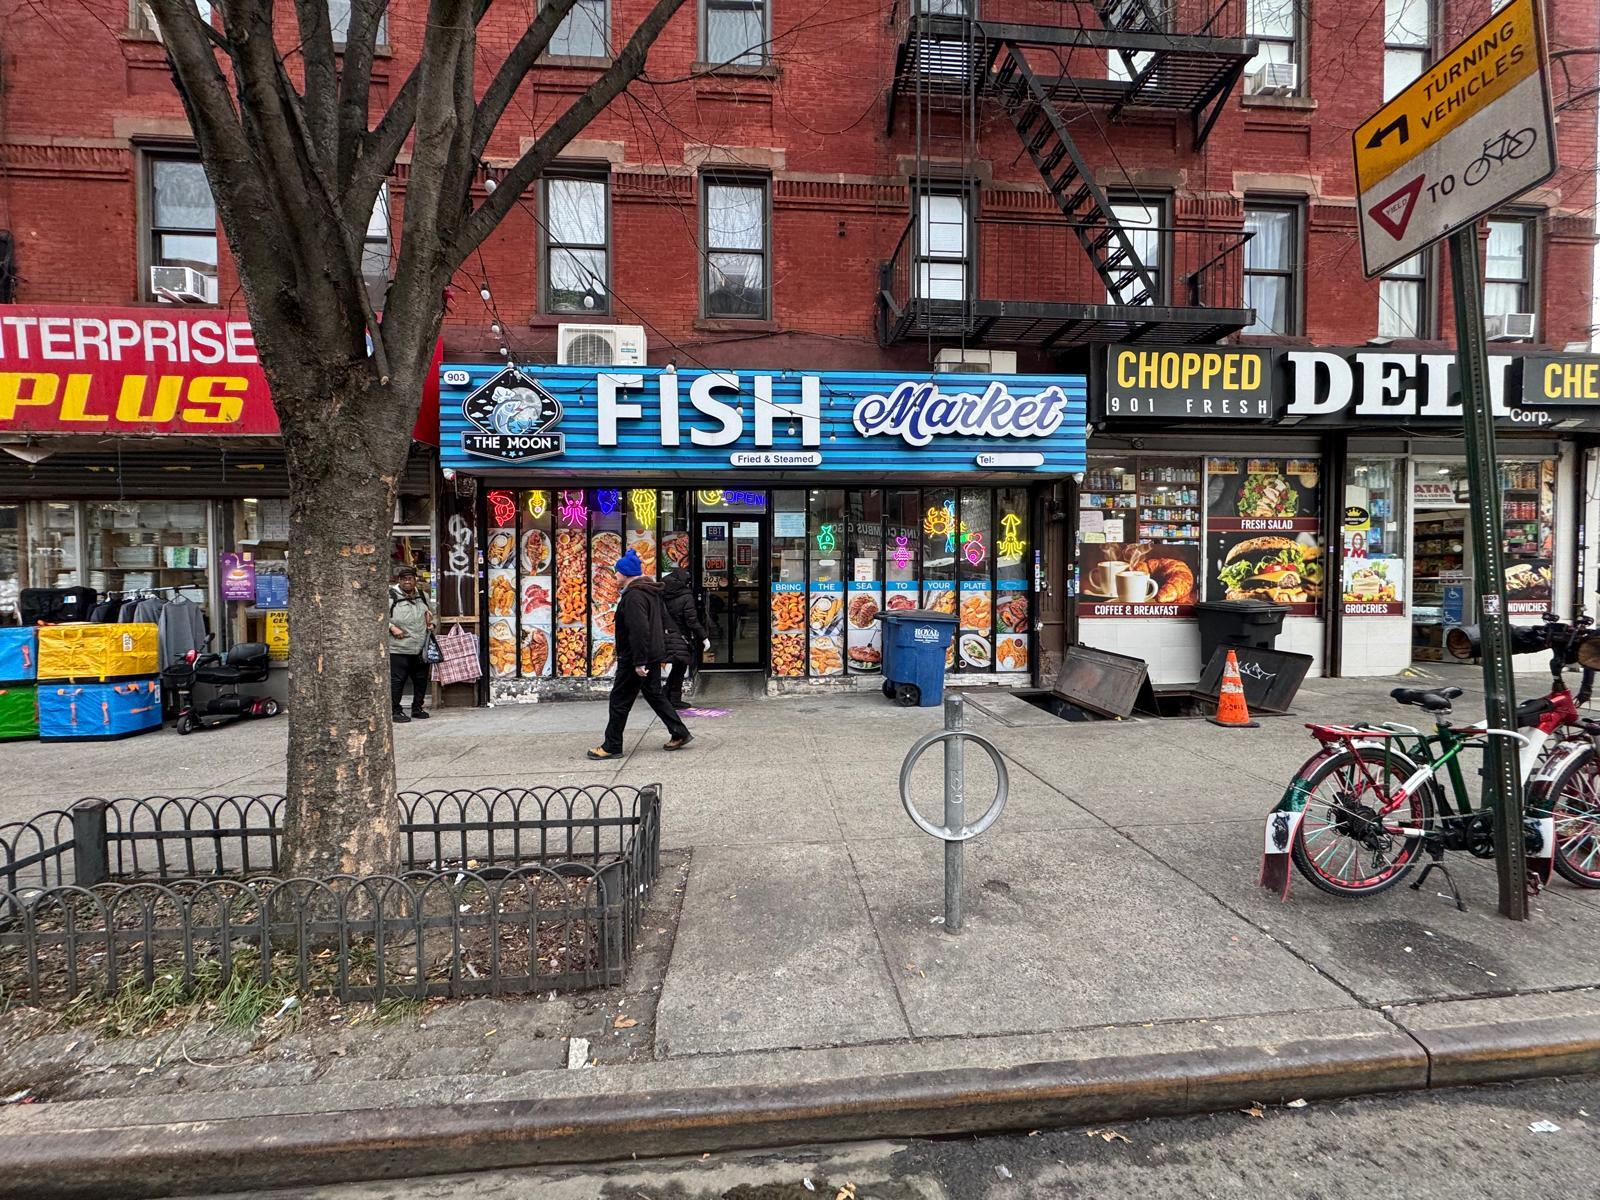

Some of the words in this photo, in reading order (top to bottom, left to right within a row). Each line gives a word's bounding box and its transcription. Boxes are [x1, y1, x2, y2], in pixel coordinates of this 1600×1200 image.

[1423, 21, 1514, 101] TURNING
[1421, 44, 1524, 129] VEHICLES
[1427, 174, 1455, 203] TO
[1385, 198, 1408, 215] YIELD
[1117, 350, 1262, 391] CHOPPED
[447, 373, 466, 382] 903
[1287, 351, 1513, 416] DELI
[0, 372, 249, 423] PLUS
[597, 372, 820, 447] FISH
[1111, 397, 1154, 412] 901
[1186, 399, 1267, 414] FRESH
[857, 384, 1064, 442] Market
[1510, 408, 1552, 425] Corp.
[473, 436, 500, 449] THE
[507, 437, 552, 449] MOON
[737, 455, 763, 463] Fried
[764, 455, 772, 463] &
[773, 455, 814, 463] Steamed
[979, 455, 995, 464] Tel:
[1414, 484, 1451, 493] ATM
[724, 490, 764, 506] OPEN
[708, 526, 722, 535] EBT
[1241, 520, 1266, 529] FRESH
[1268, 520, 1293, 530] SALAD
[706, 560, 725, 569] OPEN
[818, 583, 836, 591] THE
[1094, 605, 1124, 615] COFFEE
[1125, 606, 1132, 615] &
[1133, 606, 1179, 615] BREAKFAST
[1345, 603, 1388, 614] GROCERIES
[1507, 602, 1548, 612] NDWICHES
[914, 628, 940, 637] ROYAL
